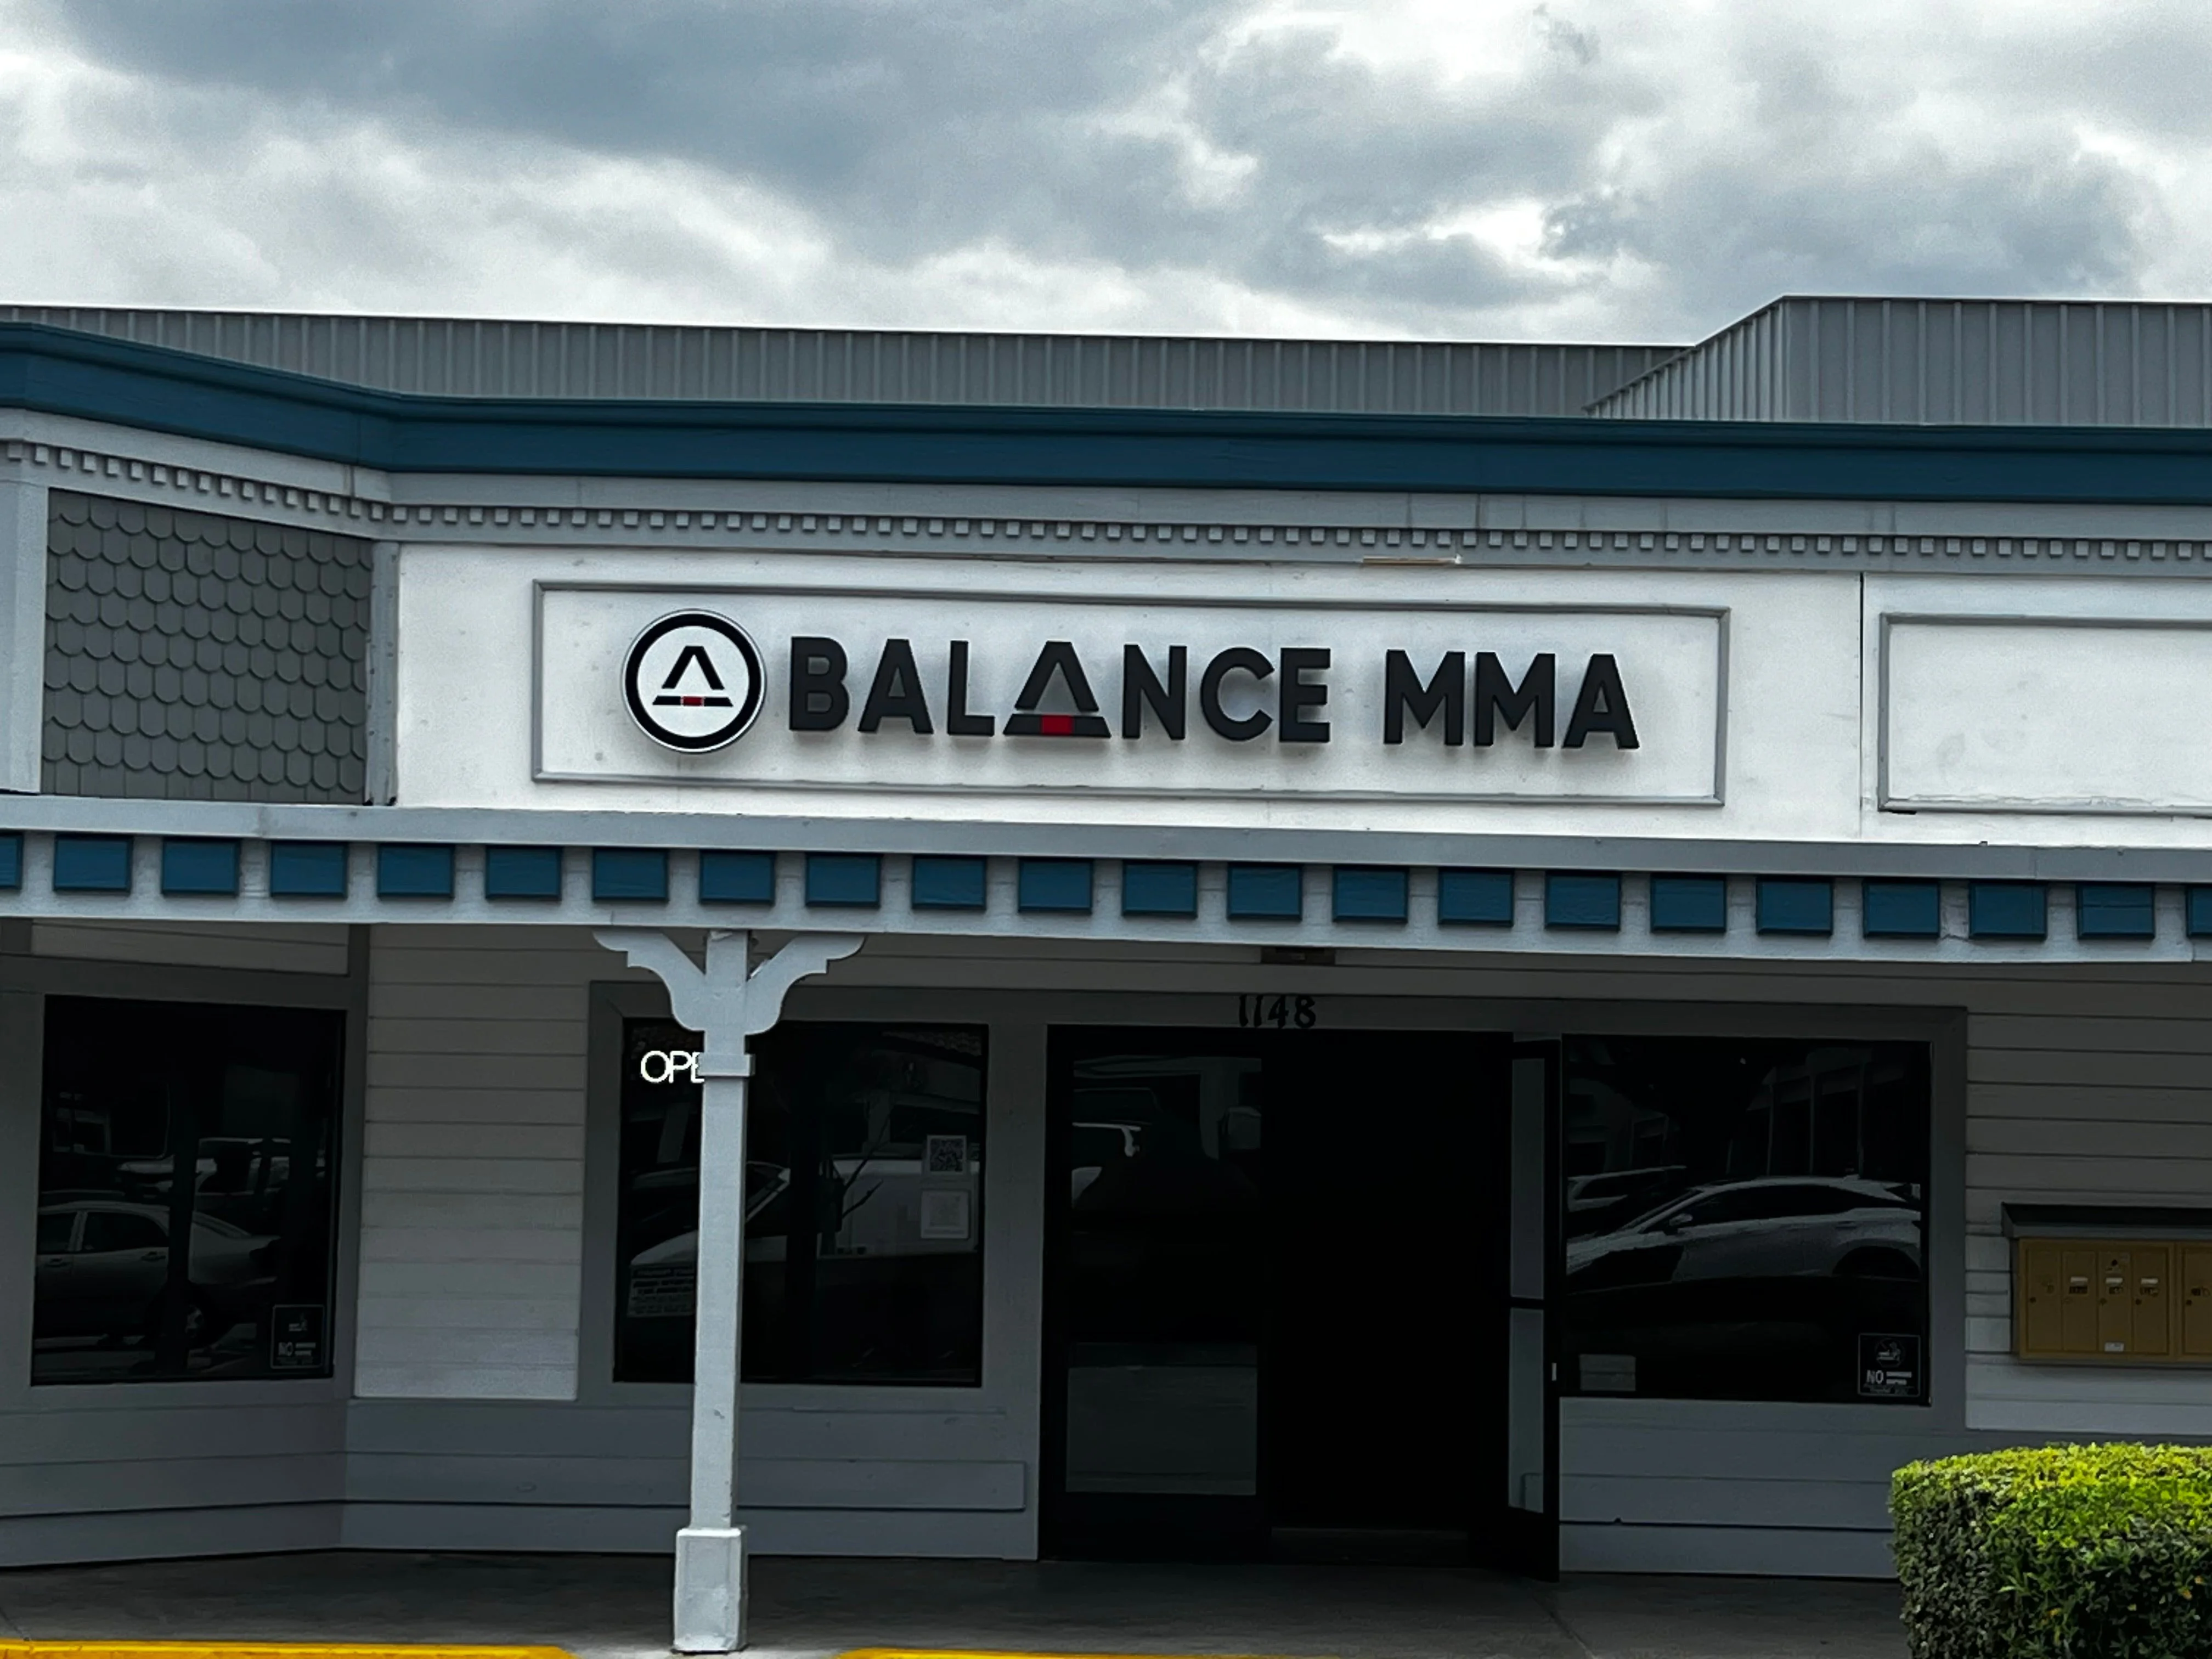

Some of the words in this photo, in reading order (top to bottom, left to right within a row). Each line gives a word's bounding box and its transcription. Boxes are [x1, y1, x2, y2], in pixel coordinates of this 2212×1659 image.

[788, 635, 1331, 744] BALANCE
[1383, 648, 1640, 749] MMA
[1239, 994, 1316, 1029] 1148
[640, 1050, 705, 1084] OPE
[1866, 1369, 1884, 1385] NO
